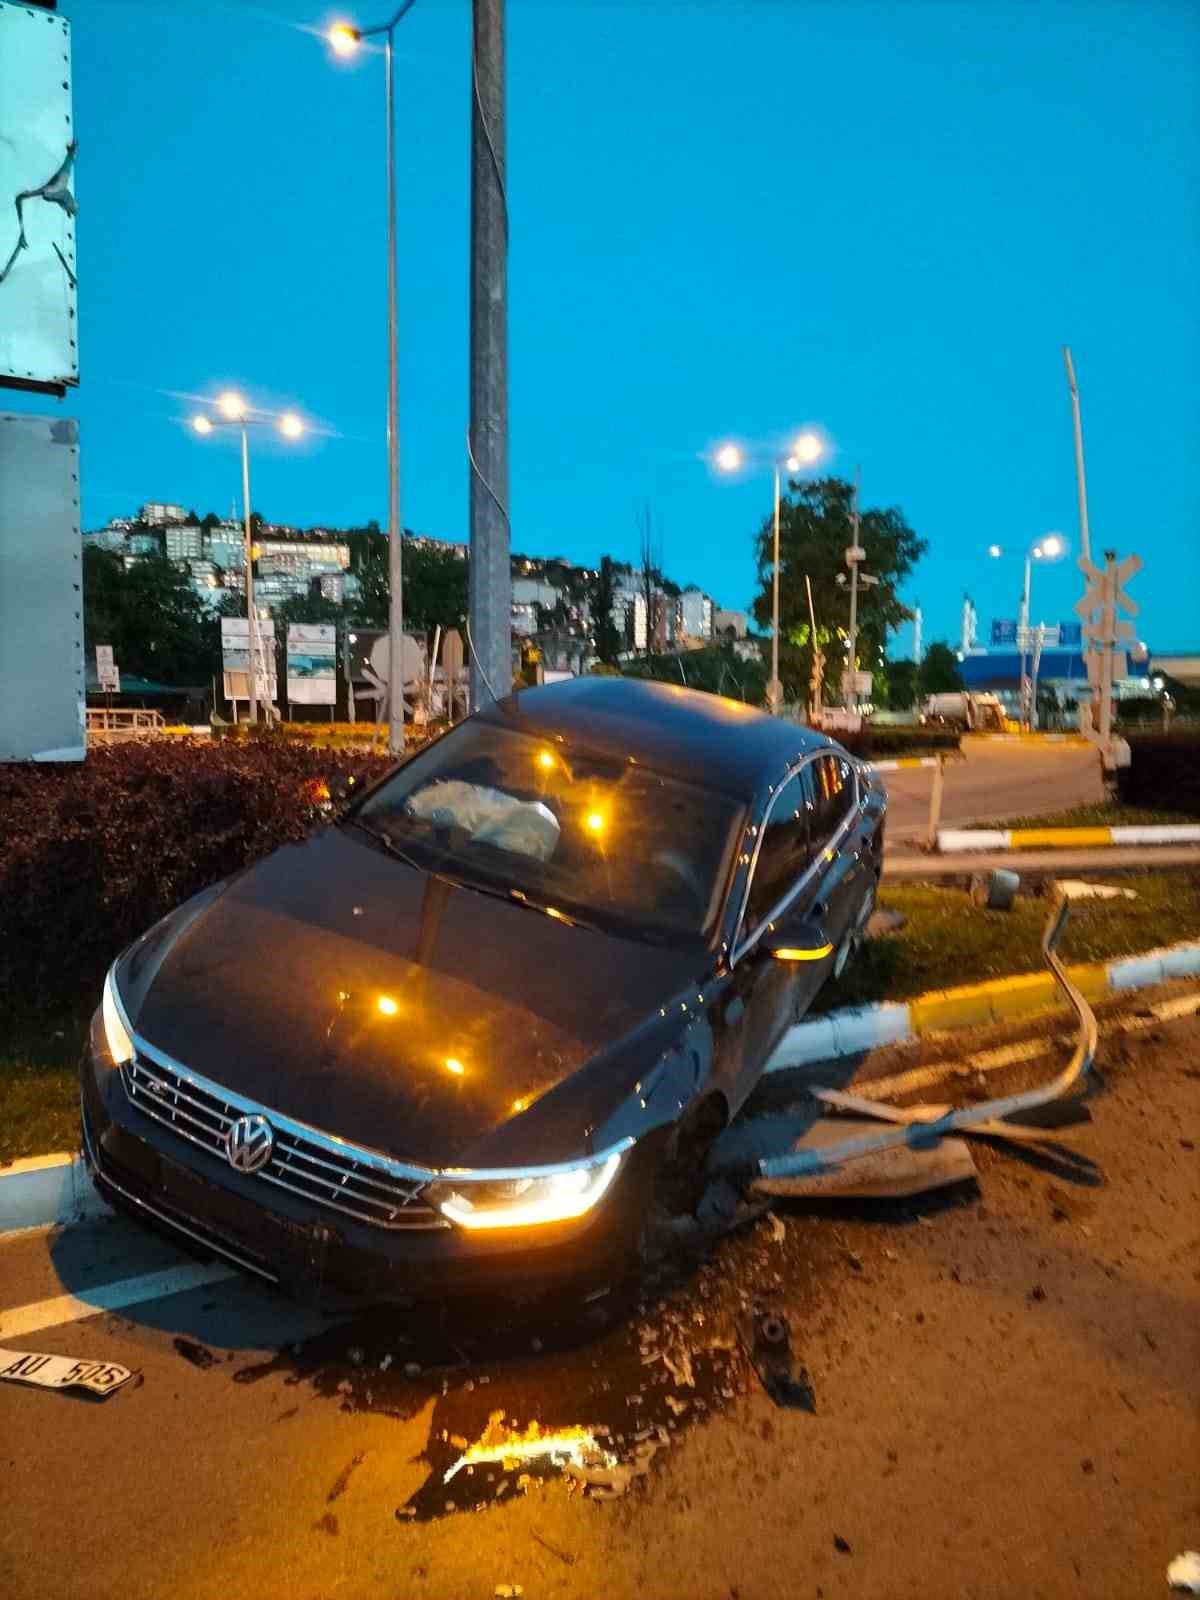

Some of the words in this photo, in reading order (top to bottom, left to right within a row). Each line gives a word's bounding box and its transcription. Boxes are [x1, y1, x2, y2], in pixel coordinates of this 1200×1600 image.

[228, 1115, 272, 1171] VW
[0, 1355, 52, 1376] AU
[61, 1362, 124, 1385] 505
